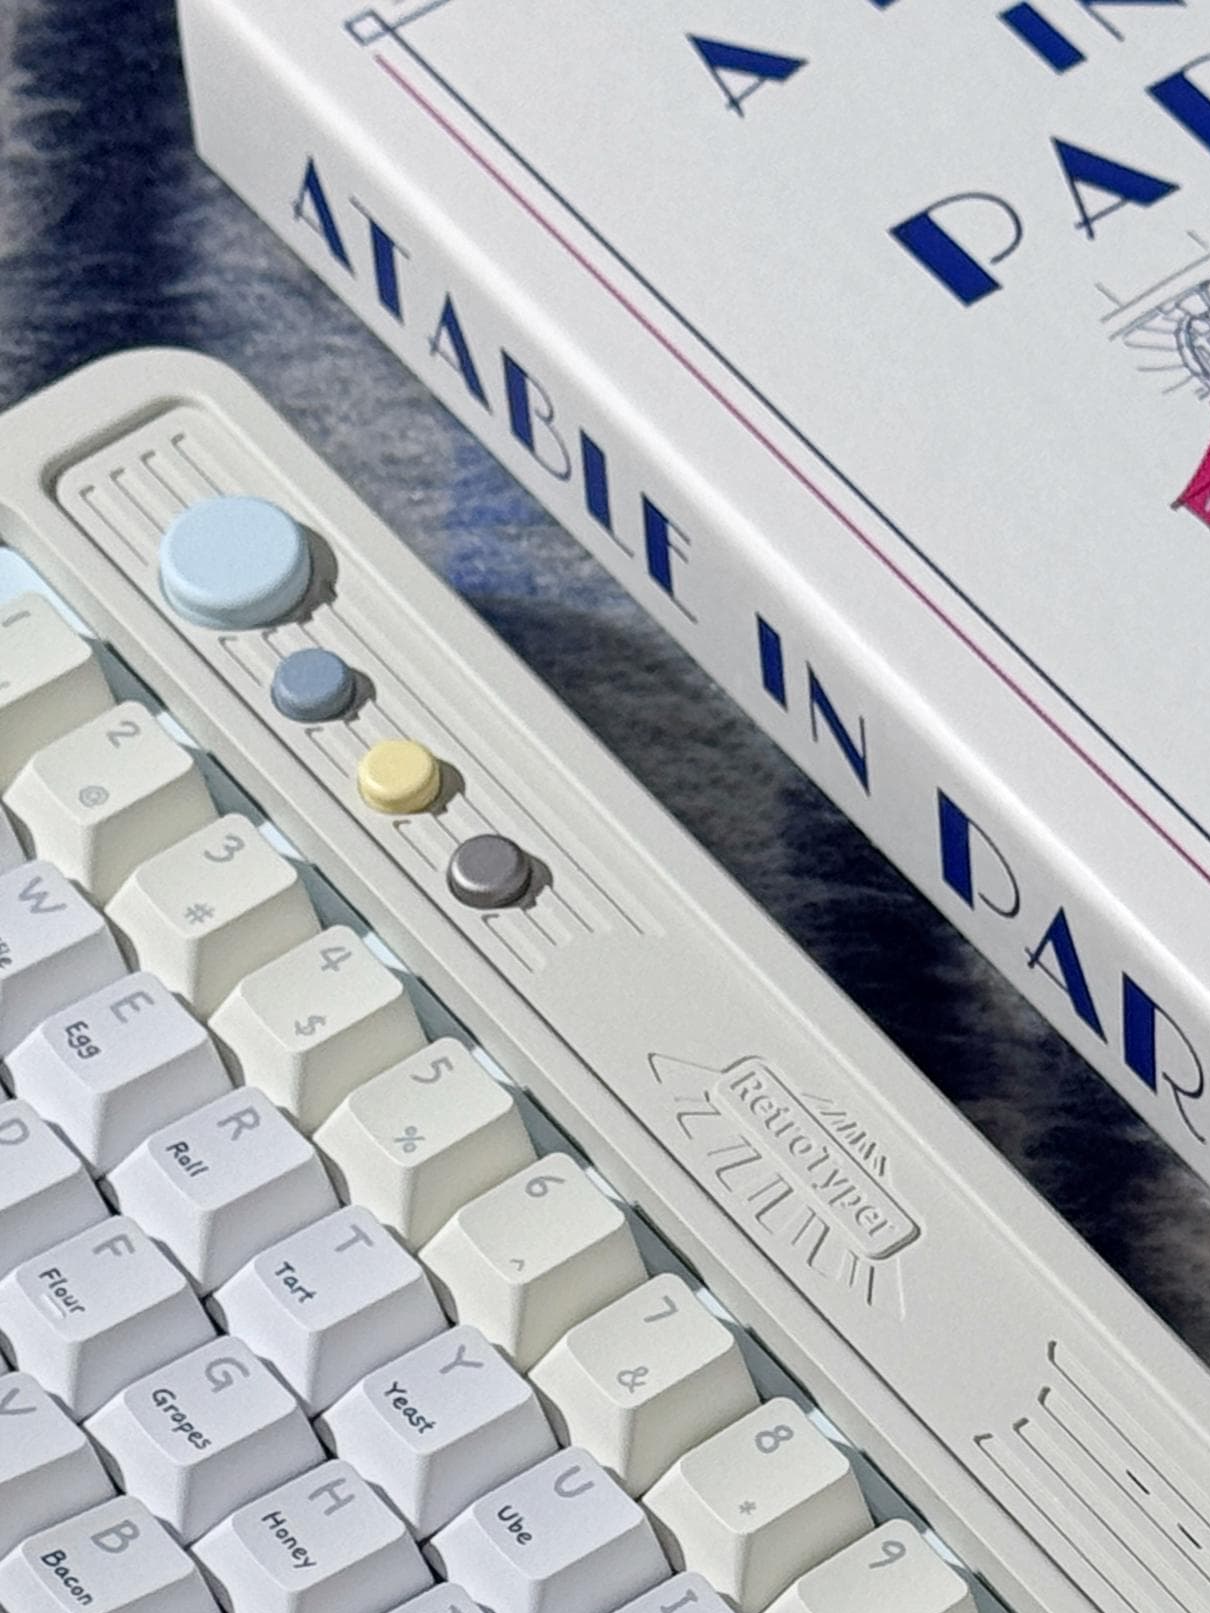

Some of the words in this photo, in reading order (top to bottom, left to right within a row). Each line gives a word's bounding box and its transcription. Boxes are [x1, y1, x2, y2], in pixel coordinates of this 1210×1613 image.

[686, 33, 808, 117] A
[756, 611, 870, 797] IN
[105, 720, 142, 749] 2
[203, 834, 246, 865] 3
[17, 876, 68, 917] W
[318, 946, 352, 973] 4
[109, 990, 156, 1024] E
[65, 1020, 102, 1061] Egg
[410, 1057, 453, 1084] 5
[216, 1107, 261, 1142] R
[165, 1140, 210, 1179] Roll
[525, 1175, 566, 1198] 6
[92, 1233, 136, 1257] F
[334, 1224, 375, 1253] T
[38, 1267, 86, 1315] Flour
[274, 1260, 318, 1306] Tart
[644, 1295, 679, 1323] 7
[204, 1356, 251, 1395] G
[439, 1345, 484, 1374] Y
[151, 1387, 213, 1451] Grapes
[383, 1382, 437, 1434] Yeast
[754, 1424, 794, 1454] 8
[307, 1477, 357, 1517] H
[553, 1465, 595, 1498] U
[90, 1519, 141, 1554] B
[260, 1509, 318, 1571] Honey
[497, 1505, 533, 1546] Ube
[868, 1540, 906, 1569] 9
[40, 1548, 95, 1606] Bacon
